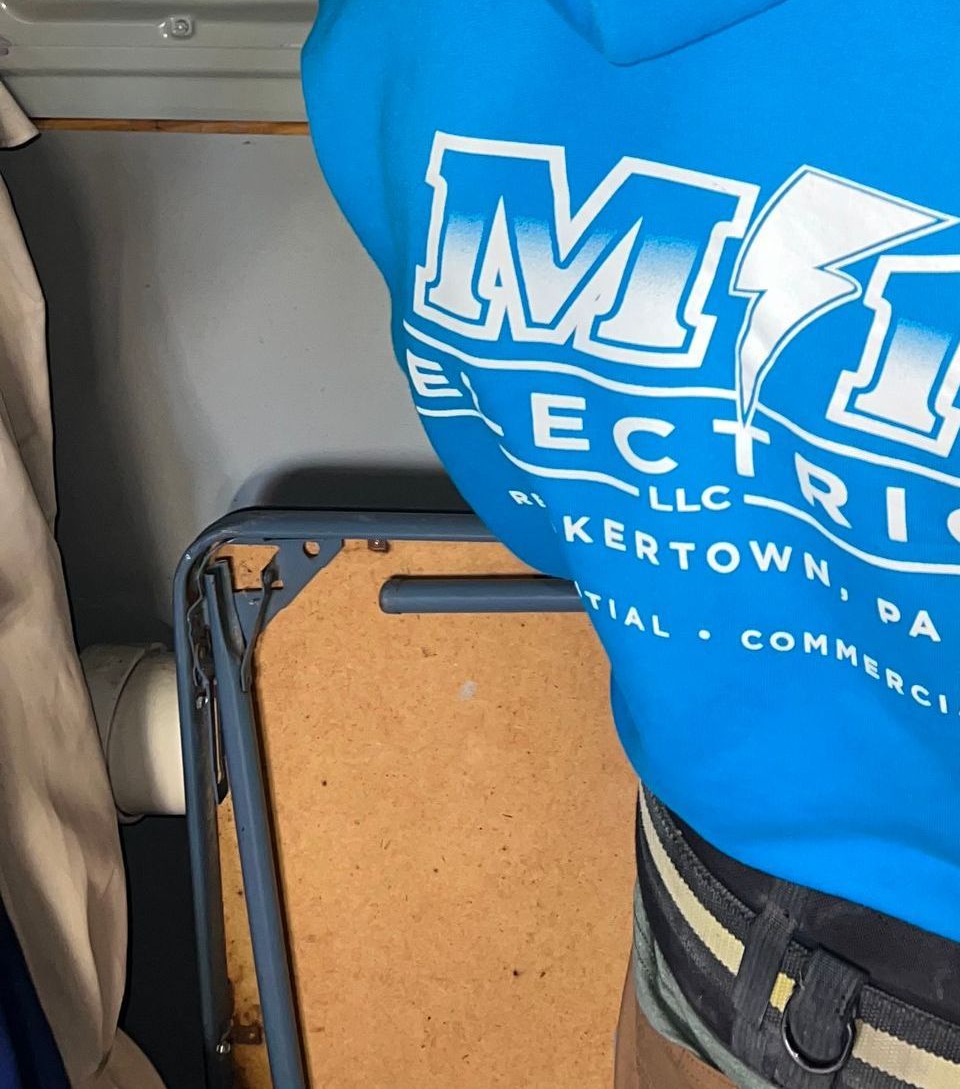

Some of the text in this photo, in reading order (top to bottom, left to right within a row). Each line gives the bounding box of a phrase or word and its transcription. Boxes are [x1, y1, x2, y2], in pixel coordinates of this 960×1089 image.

[649, 485, 731, 512] LLC
[551, 515, 941, 642] KERTOWN, PA
